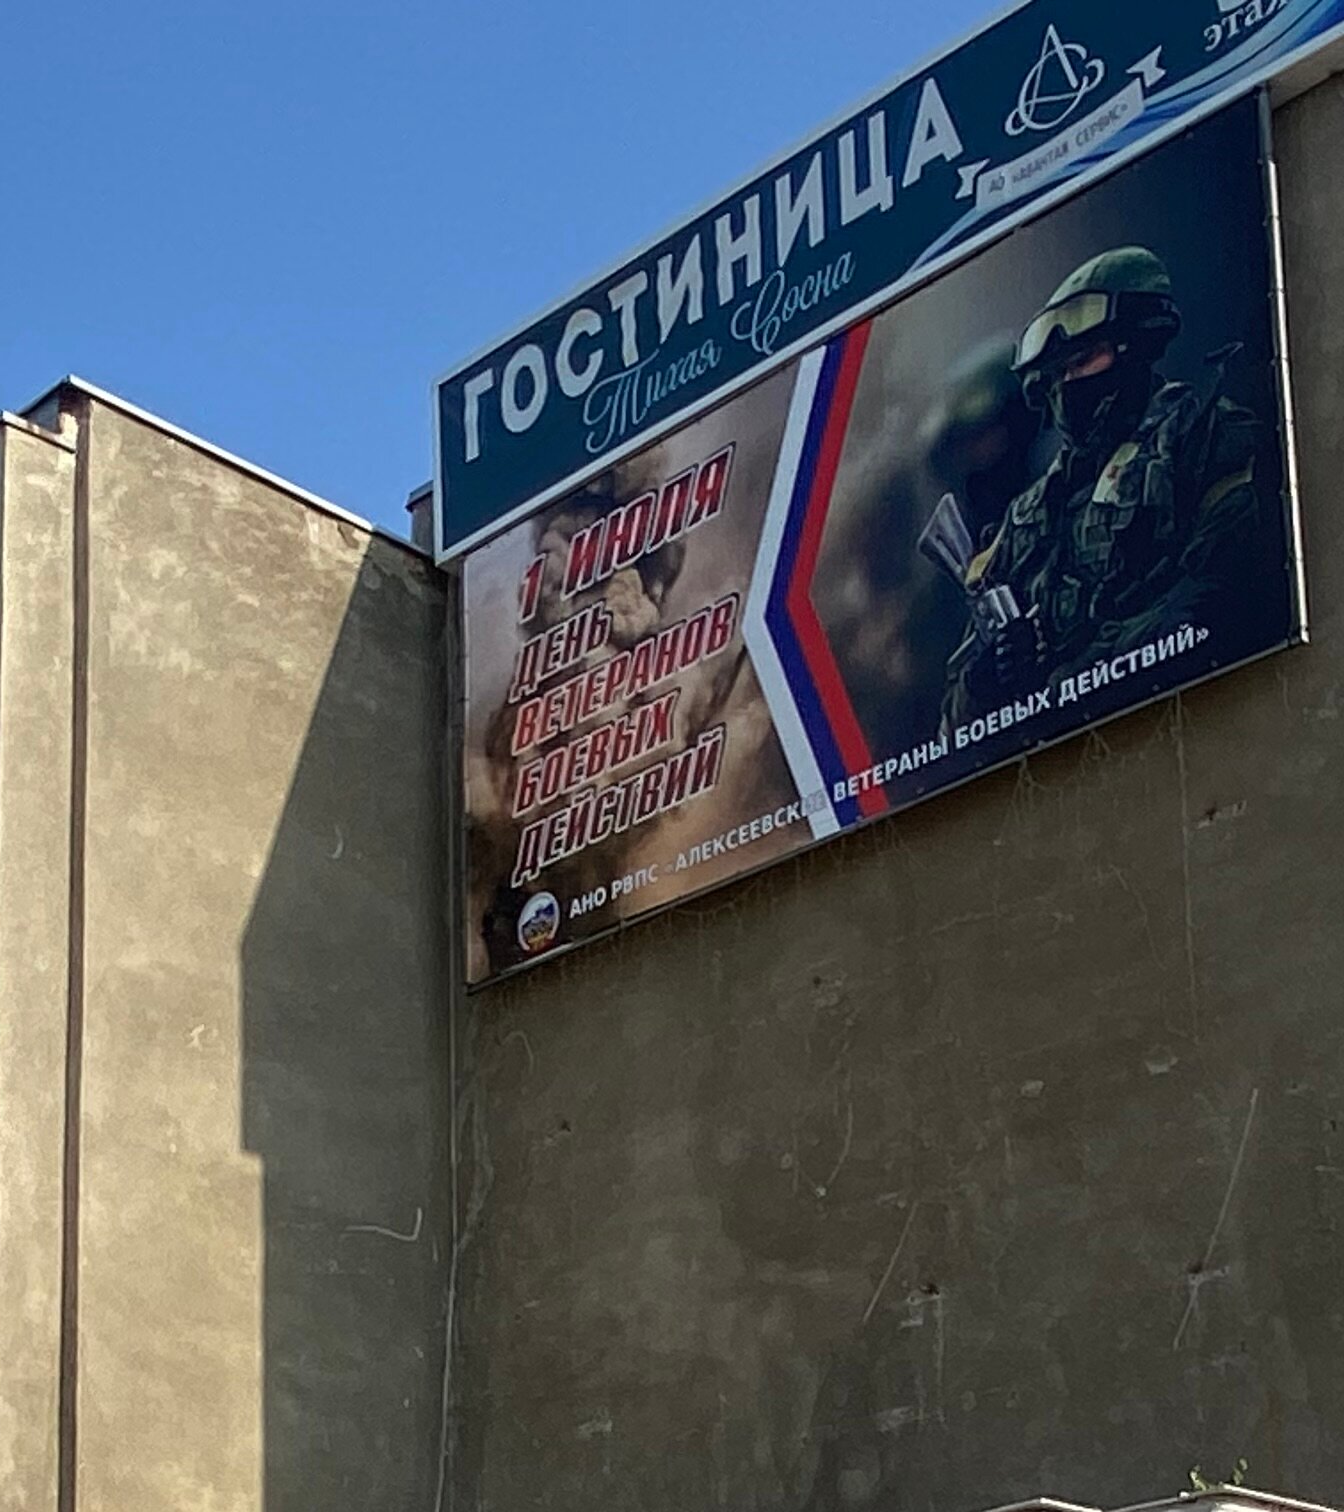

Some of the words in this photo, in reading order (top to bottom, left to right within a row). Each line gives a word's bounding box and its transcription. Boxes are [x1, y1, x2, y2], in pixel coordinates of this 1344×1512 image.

[1202, 0, 1288, 52] эта
[463, 77, 964, 463] ГОСТИНИЦА
[582, 338, 723, 454] Тихая
[730, 251, 856, 356] Сосна
[519, 552, 547, 625] 1
[560, 440, 737, 601] ИЮЛЯ
[509, 599, 613, 703] ДЕНЬ
[512, 591, 740, 756] ВЕТЕРАНОВ
[511, 722, 727, 889] ДЕЙСТВИЙ
[512, 687, 682, 819] БОЕВЫХ
[569, 886, 607, 919] АНО
[611, 864, 659, 900] РВПС
[833, 736, 949, 803] ВЕТЕРАНЫ
[955, 686, 1052, 750] БОЕВЫХ
[1058, 622, 1210, 708] ДЕЙСТВИЙ»
